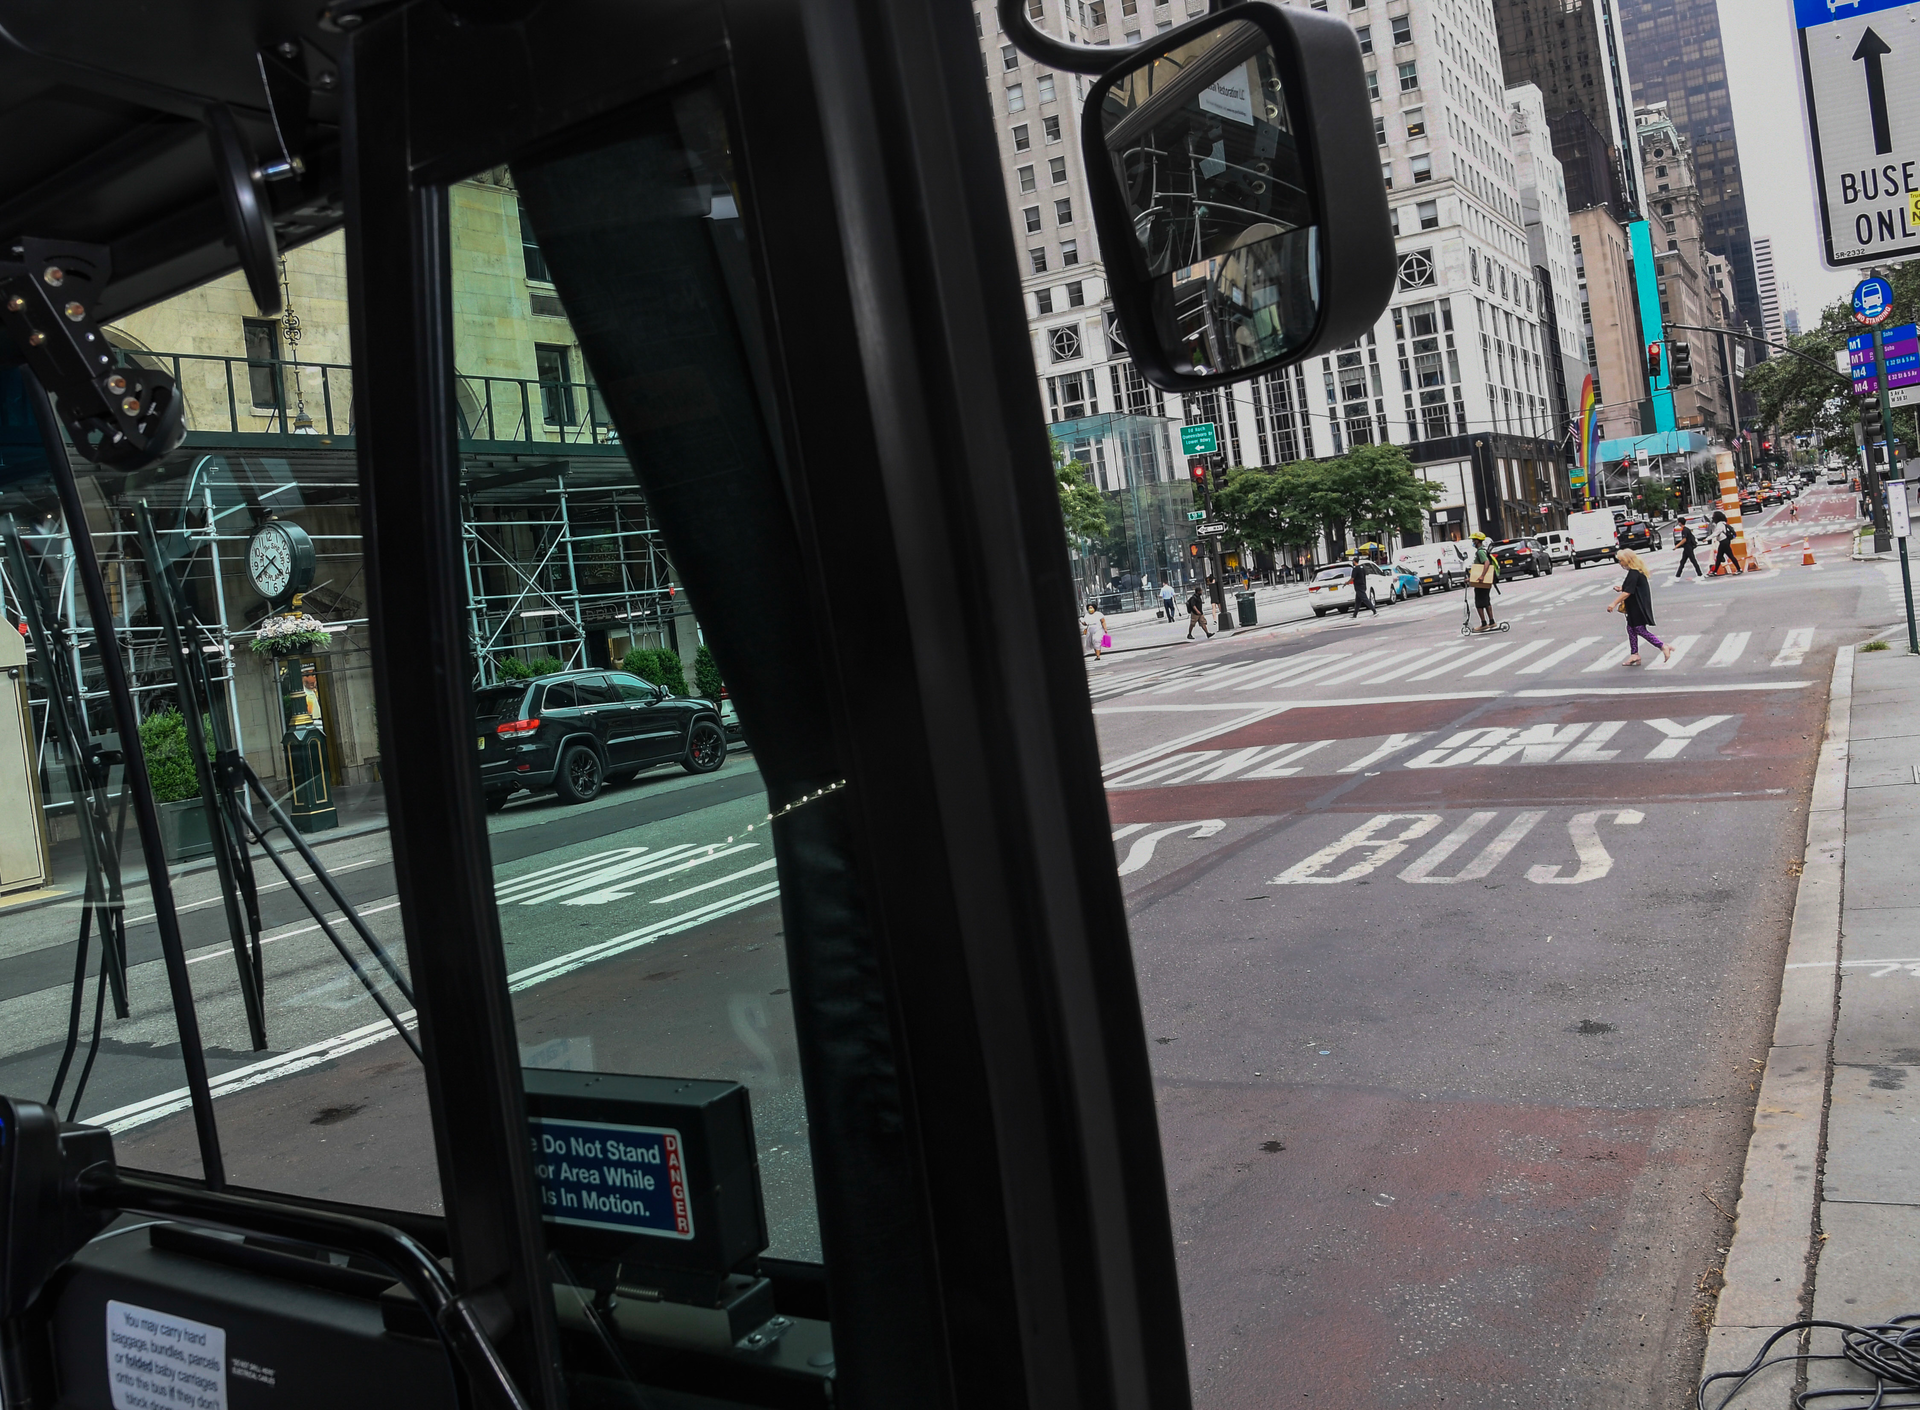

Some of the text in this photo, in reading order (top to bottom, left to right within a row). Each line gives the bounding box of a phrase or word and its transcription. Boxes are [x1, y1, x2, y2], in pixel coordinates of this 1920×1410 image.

[1841, 161, 1919, 204] BUSE
[1856, 207, 1917, 245] ONL
[1835, 248, 1866, 259] SR-2332
[1857, 305, 1892, 325] NO STANDING
[1849, 338, 1861, 350] M1
[1851, 352, 1863, 364] M1
[1853, 366, 1866, 378] M4
[1854, 380, 1868, 393] M4
[254, 561, 258, 571] 9
[265, 581, 270, 591] 7
[273, 583, 278, 592] 6
[1266, 807, 1646, 886] BUS
[542, 1134, 566, 1155] Do
[570, 1137, 603, 1159] Not
[606, 1139, 661, 1165] Stand
[534, 1162, 655, 1191] or Area While
[664, 1136, 690, 1232] DANGER
[542, 1186, 650, 1217] Is In Motion.
[124, 1311, 206, 1347] You may carry hand
[111, 1329, 221, 1372] baggage, bundles, parcels
[114, 1352, 219, 1392] or folded baby carriages
[116, 1372, 135, 1387] onto
[135, 1376, 150, 1391] the
[150, 1381, 168, 1397] bus
[168, 1385, 176, 1400] if
[176, 1388, 196, 1408] they
[124, 1391, 149, 1409] block
